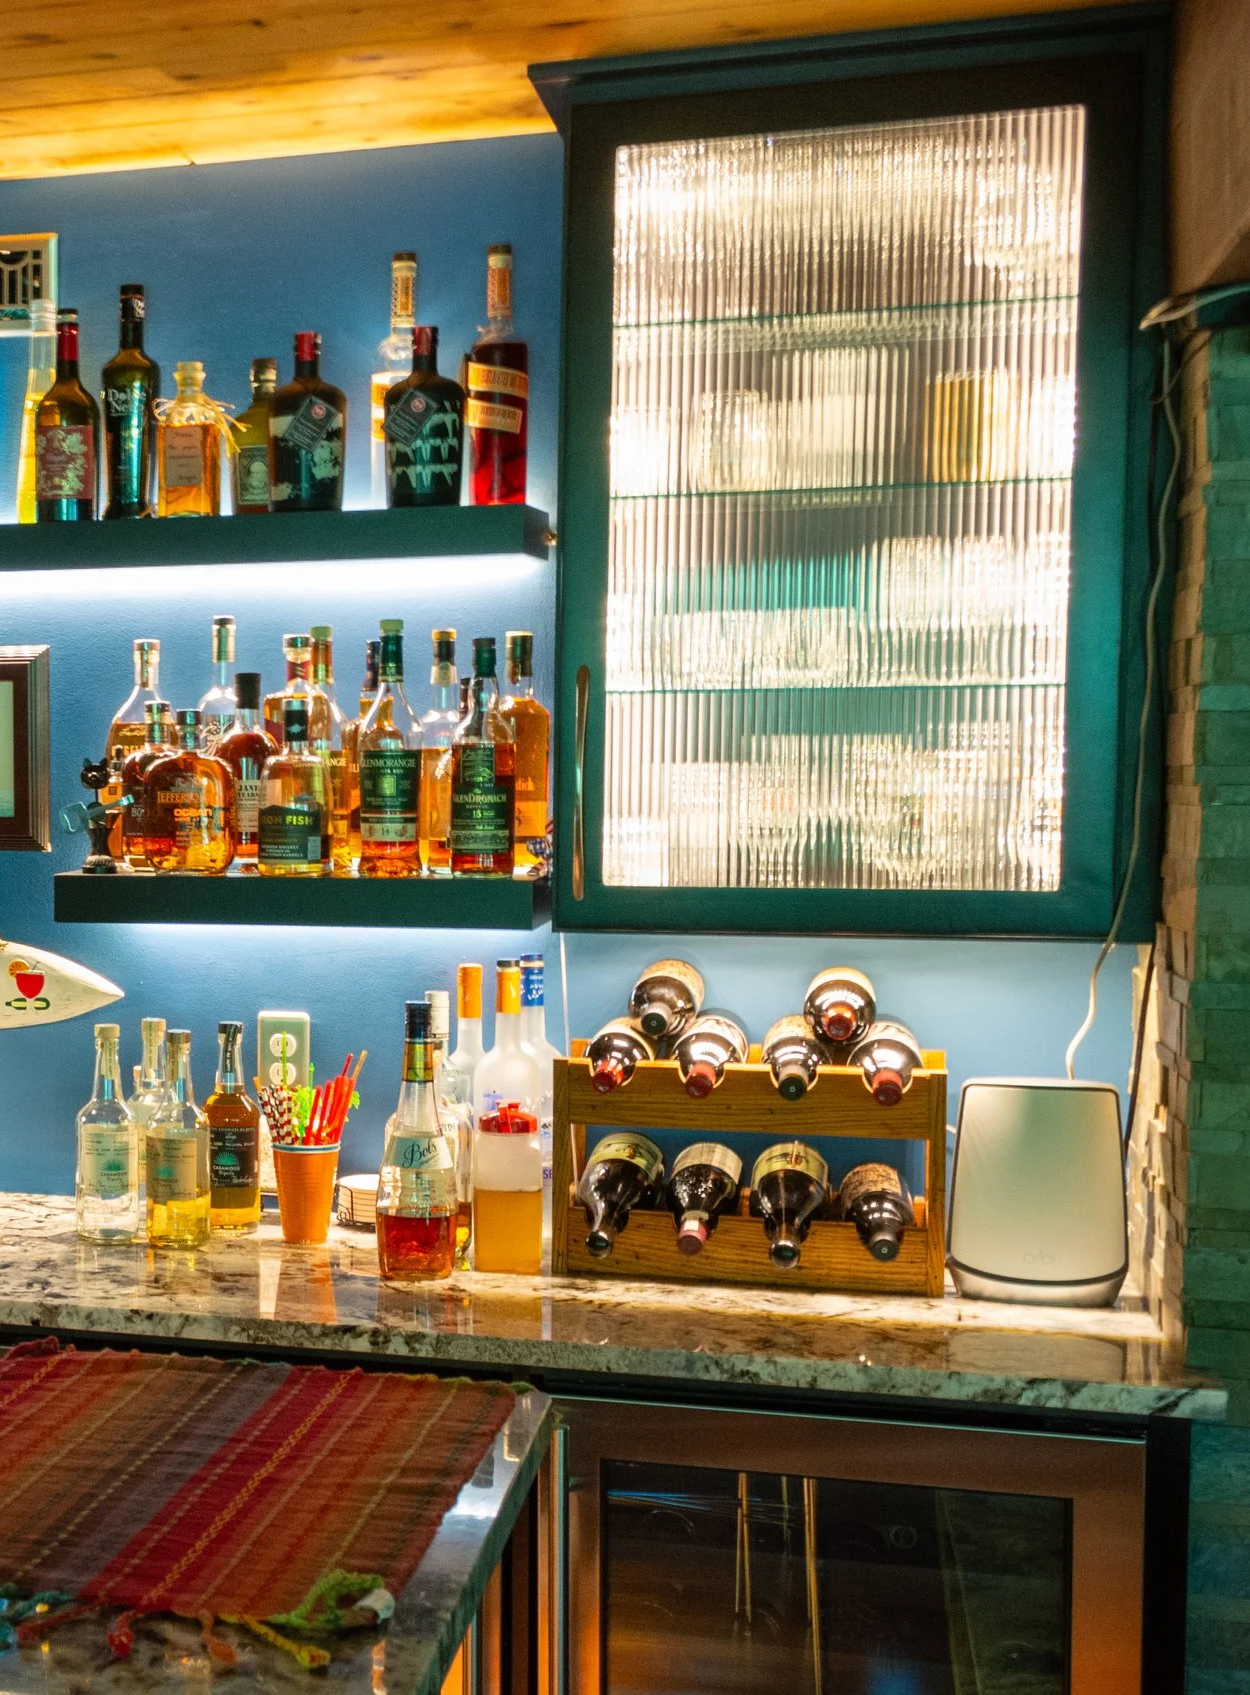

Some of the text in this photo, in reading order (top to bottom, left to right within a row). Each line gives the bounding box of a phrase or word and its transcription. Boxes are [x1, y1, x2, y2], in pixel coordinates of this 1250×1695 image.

[453, 792, 507, 804] GLENDRONACH
[286, 815, 313, 825] FISH
[402, 1138, 437, 1169] Bols
